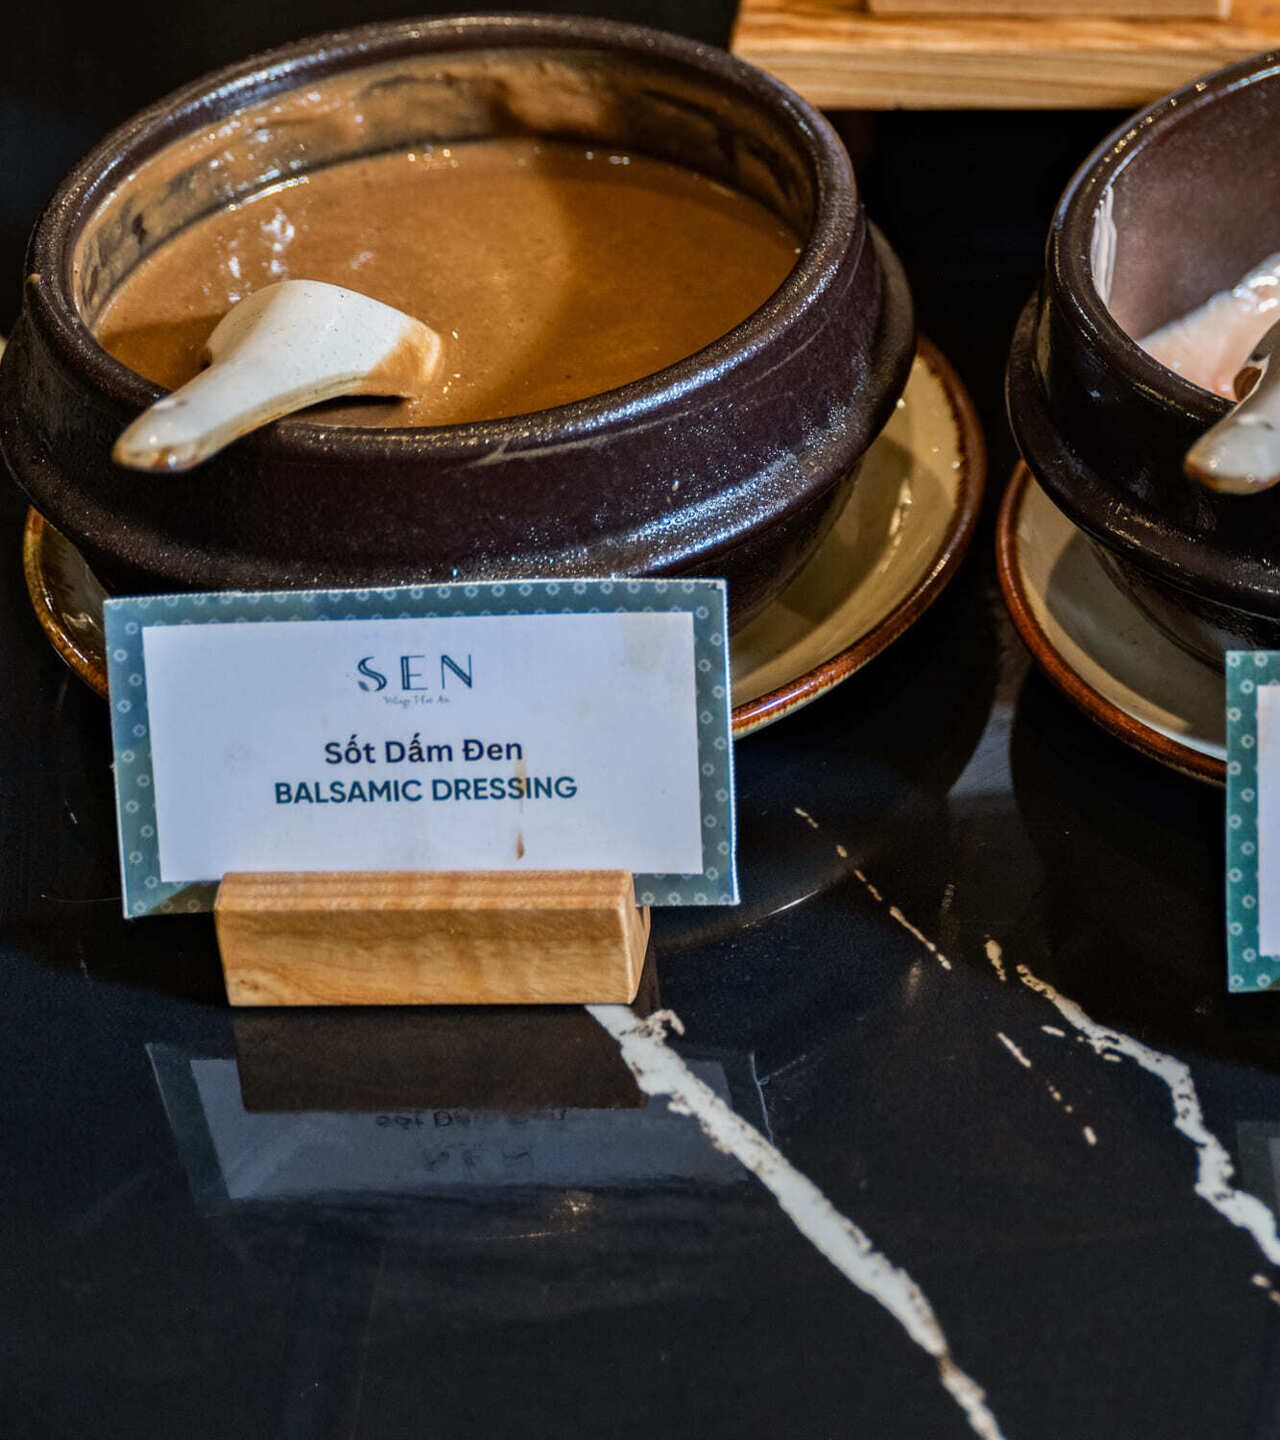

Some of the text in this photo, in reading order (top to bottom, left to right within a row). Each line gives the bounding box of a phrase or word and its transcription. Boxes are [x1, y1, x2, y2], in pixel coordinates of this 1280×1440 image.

[357, 654, 473, 692] SEN
[324, 733, 523, 764] Sốt Dấm Đen
[275, 776, 577, 804] BALSAMIC DRESSING
